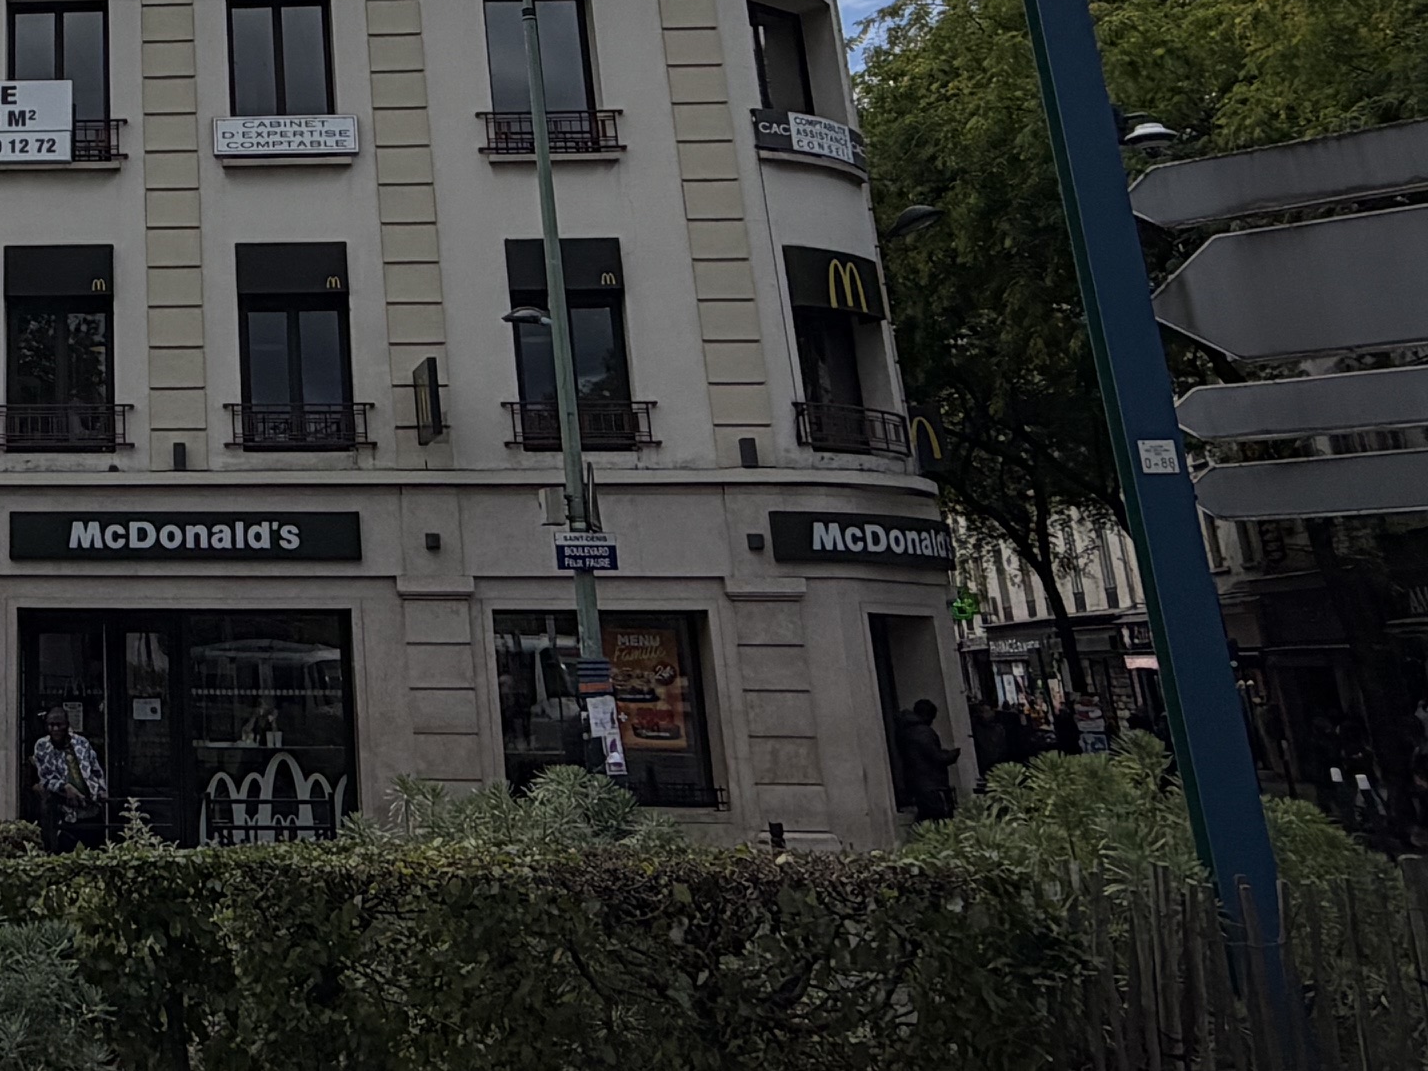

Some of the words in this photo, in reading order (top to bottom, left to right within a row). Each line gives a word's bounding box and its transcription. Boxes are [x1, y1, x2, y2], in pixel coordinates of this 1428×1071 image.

[242, 120, 328, 129] CABINET
[222, 129, 351, 140] D'EXPERTISE
[9, 138, 30, 154] 12
[35, 138, 57, 154] 72
[226, 139, 348, 150] COMPTABLE
[69, 521, 300, 550] McDonald's
[564, 546, 610, 556] BOULEVARD
[617, 633, 660, 647] MENU
